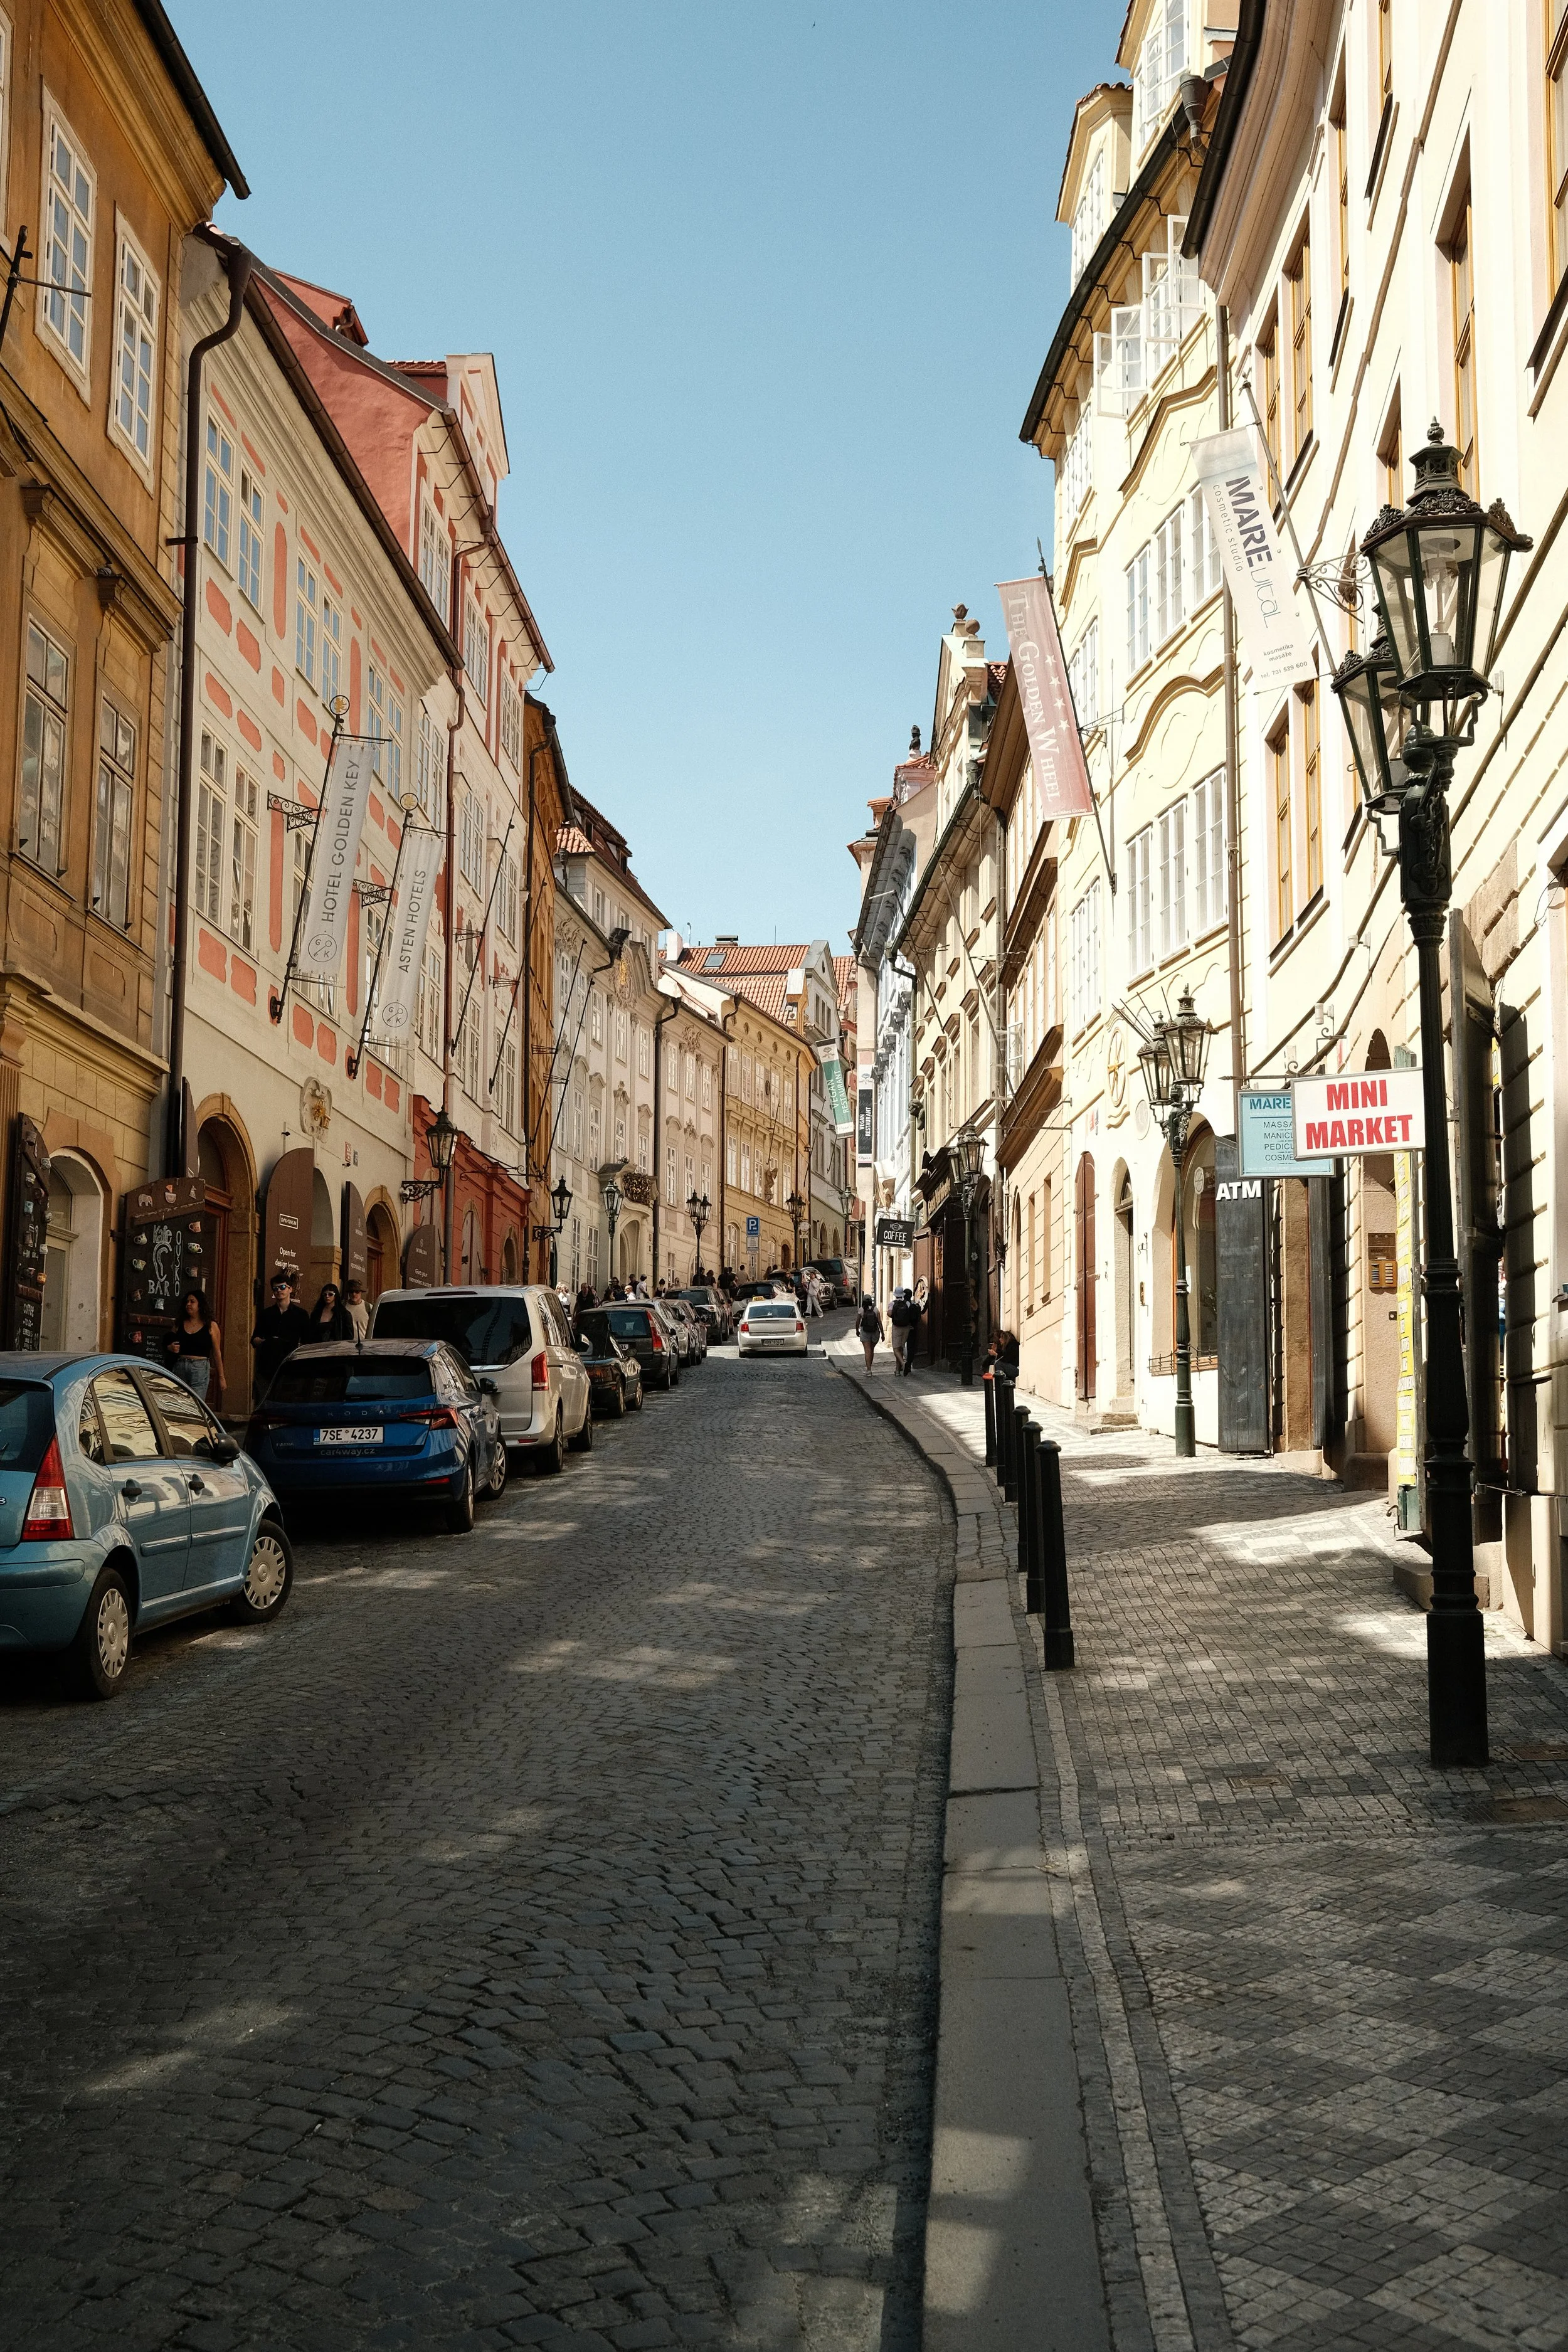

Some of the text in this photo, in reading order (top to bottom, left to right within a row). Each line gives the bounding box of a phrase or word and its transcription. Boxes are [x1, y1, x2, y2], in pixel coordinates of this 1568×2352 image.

[1213, 484, 1243, 572] cosmetic studio
[1226, 475, 1273, 568] MARE
[1263, 644, 1294, 656] kosmetika
[1008, 591, 1061, 803] THE GOLDEN WHEEL
[320, 760, 360, 923] HOTEL GOLDEN KEY
[398, 869, 426, 973] ASTEN HOTELS
[827, 1079, 839, 1109] VEGAN
[834, 1071, 849, 1113] RESTAURANT
[1249, 1098, 1291, 1110] MARE
[1327, 1079, 1388, 1111] MINI
[1306, 1114, 1413, 1150] MARKET
[1216, 1180, 1262, 1201] ATM
[883, 1231, 907, 1241] COFFEE
[275, 1259, 288, 1269] design
[279, 1247, 290, 1258] Open
[147, 1279, 171, 1297] BAR
[322, 1429, 342, 1441] 7SE
[351, 1429, 378, 1440] 4237
[320, 1448, 375, 1456] car4way.cz
